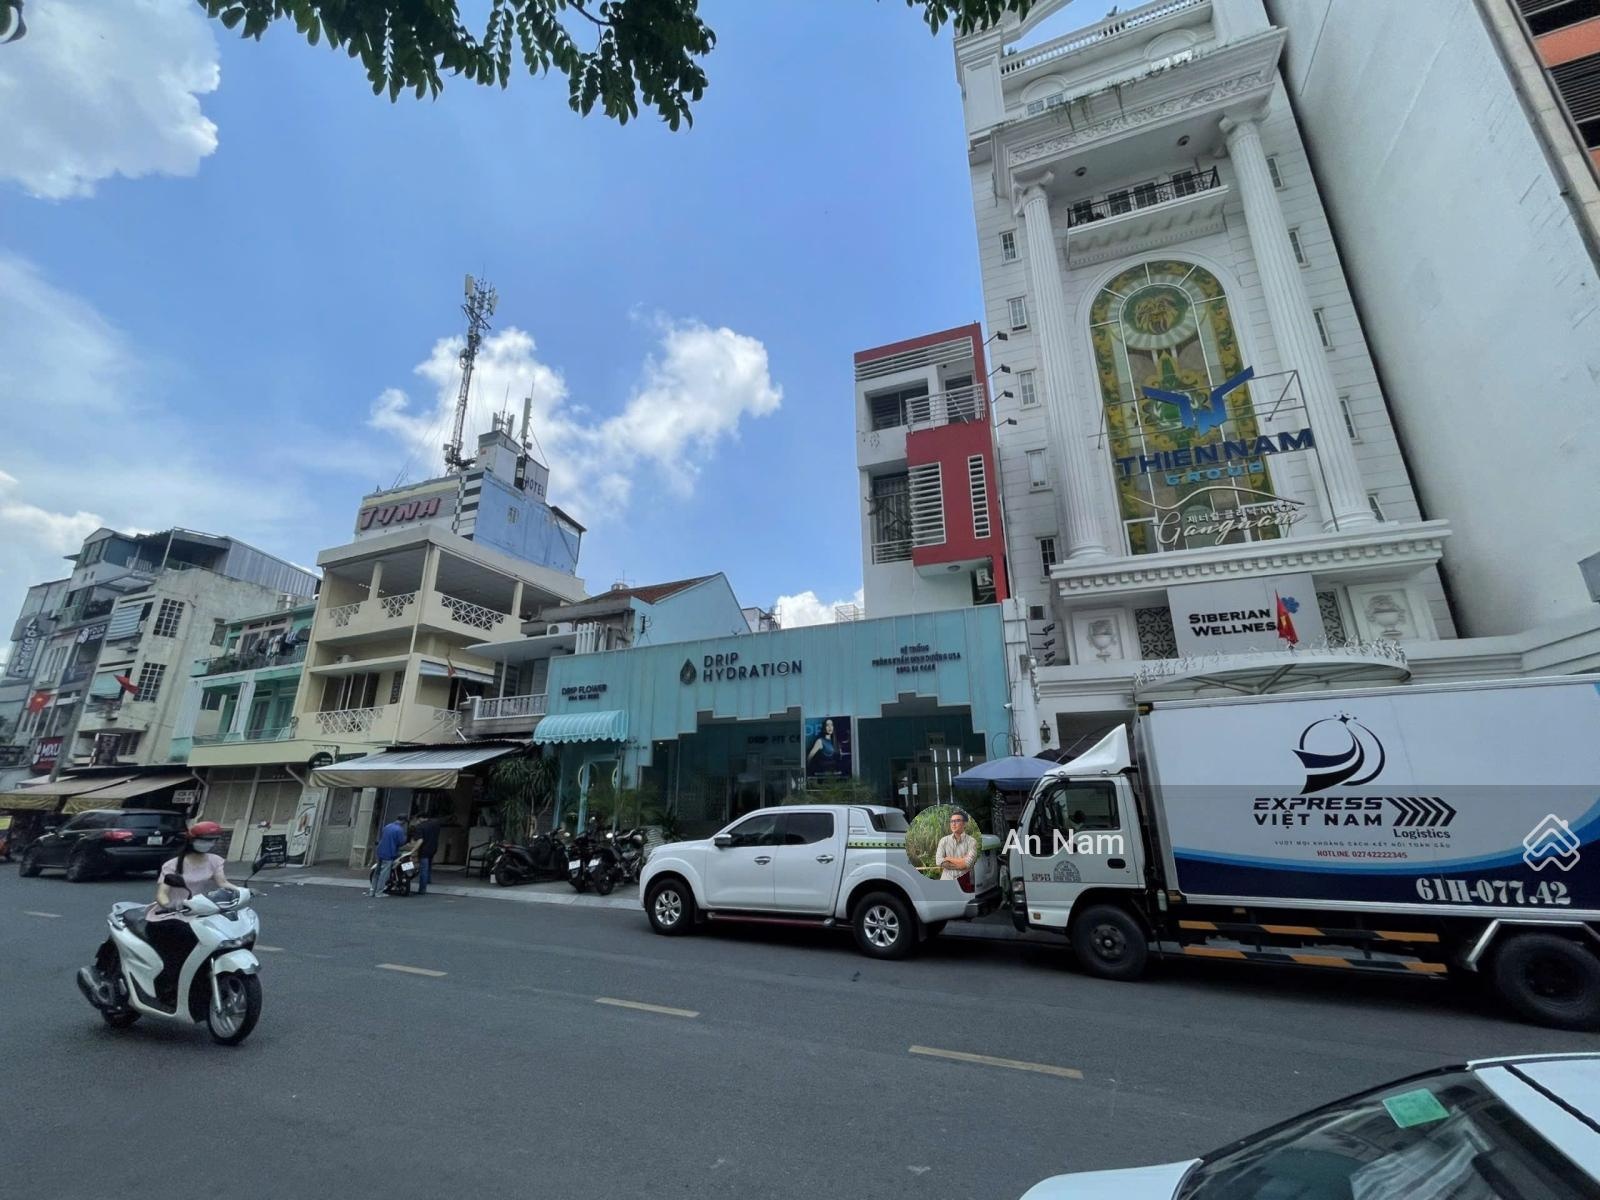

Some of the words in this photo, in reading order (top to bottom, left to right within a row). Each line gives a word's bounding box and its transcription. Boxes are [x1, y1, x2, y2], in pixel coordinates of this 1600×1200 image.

[525, 477, 545, 497] HOTEL
[1158, 511, 1308, 546] Gangnam
[1188, 608, 1271, 624] SIBERIAN
[1191, 621, 1277, 637] WELLNES
[703, 652, 739, 668] DRIP
[703, 660, 802, 682] HYDRATION
[1253, 797, 1384, 811] EXPRESS
[1254, 810, 1310, 829] VIỆT
[1324, 813, 1383, 826] NAM
[1393, 828, 1451, 840] Logistics
[1316, 849, 1350, 858] HOTLINE
[1352, 850, 1408, 859] 02742222345
[1415, 877, 1571, 905] 61H-077.42
